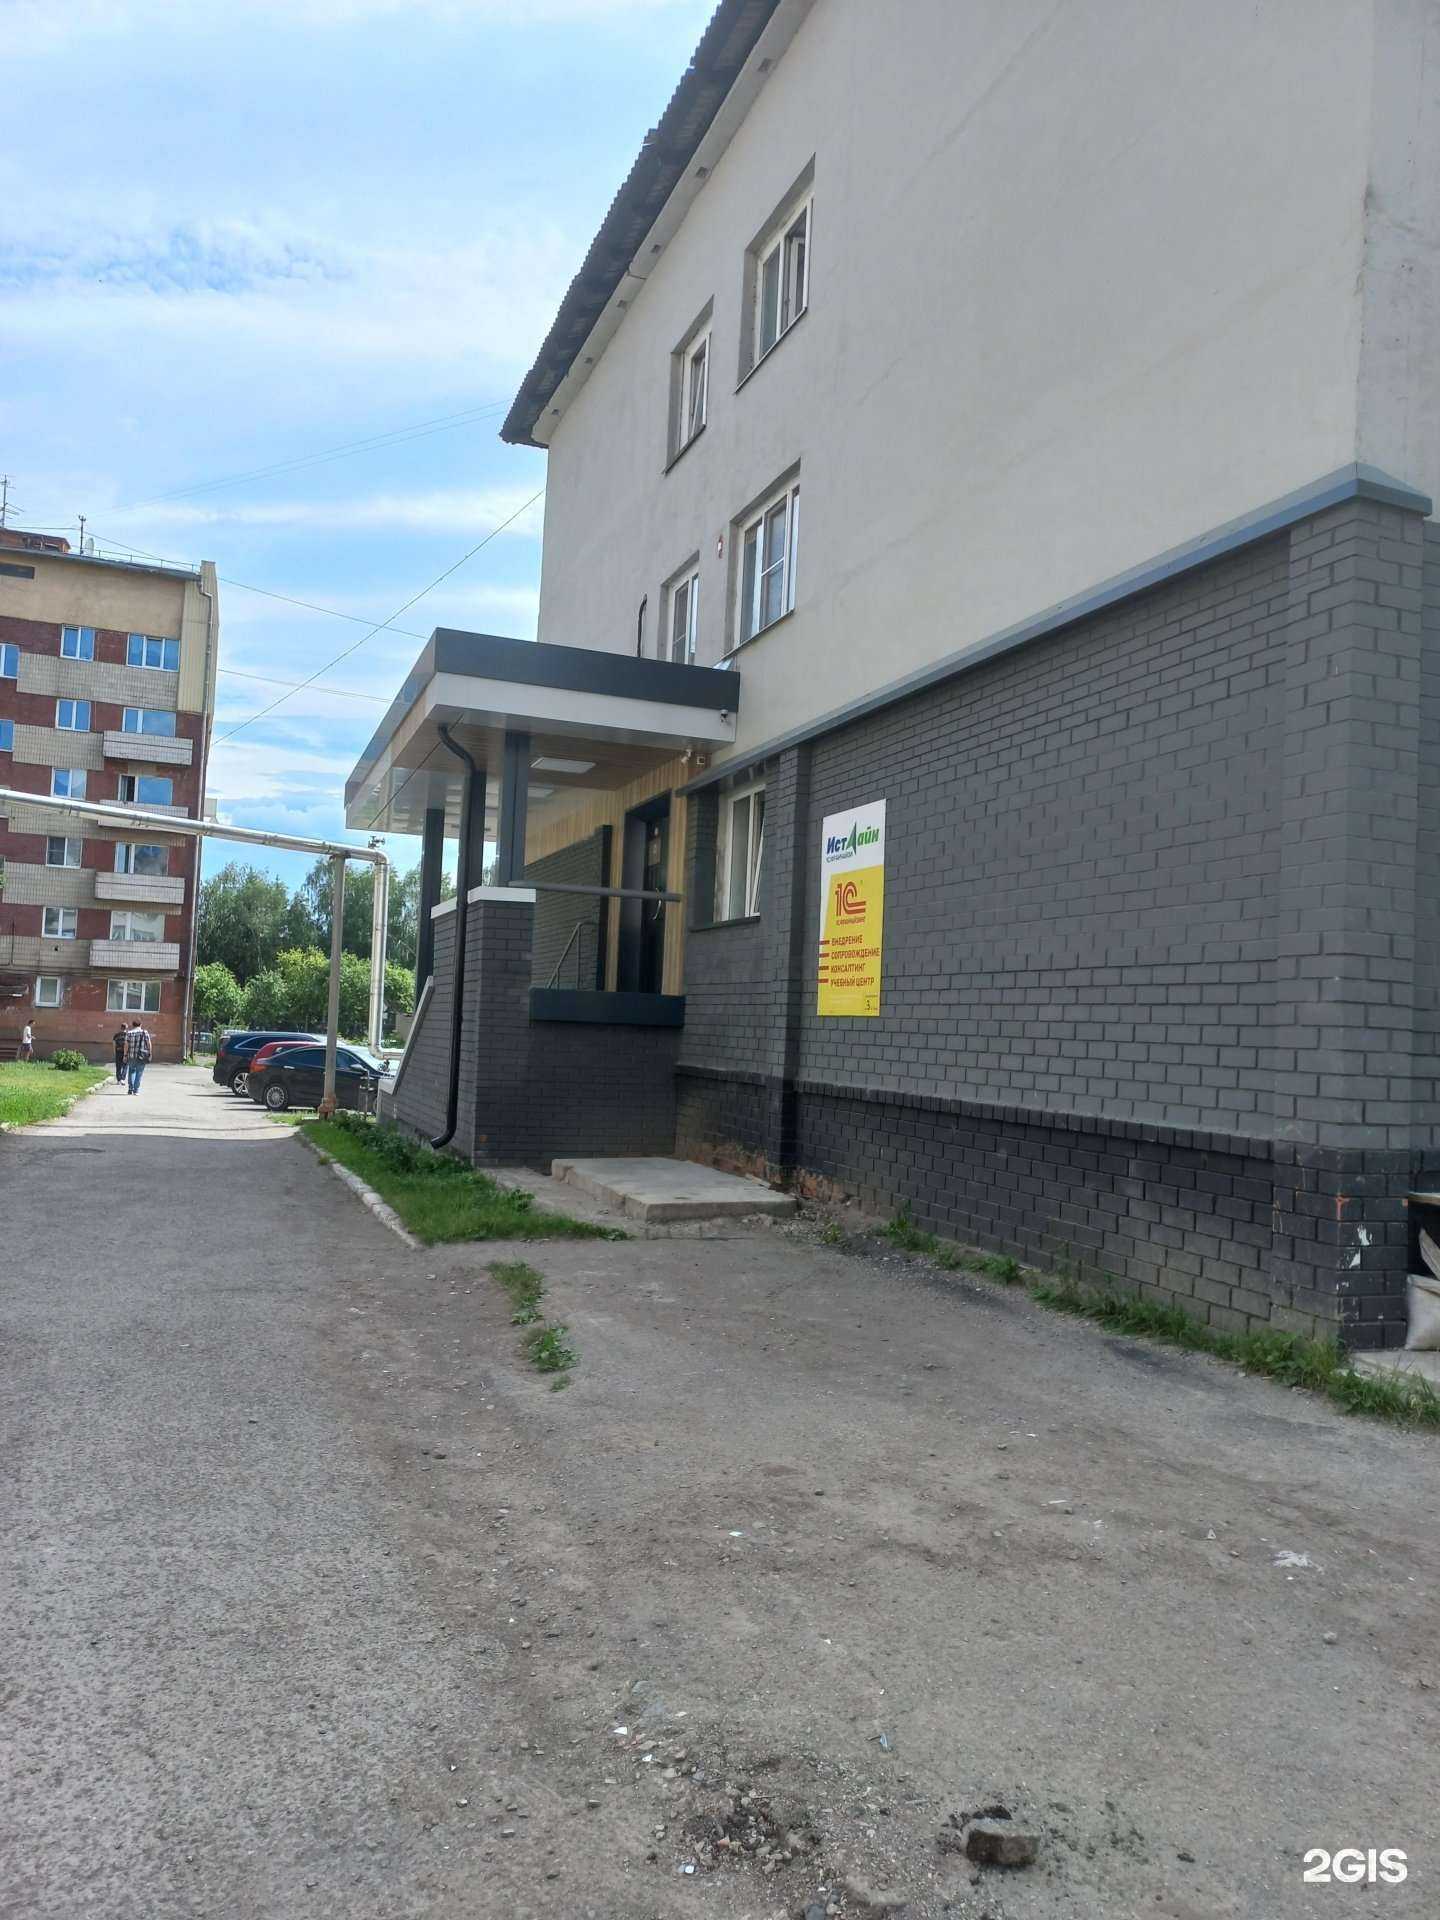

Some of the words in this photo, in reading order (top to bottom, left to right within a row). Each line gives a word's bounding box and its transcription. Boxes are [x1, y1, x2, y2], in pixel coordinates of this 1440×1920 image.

[832, 934, 863, 946] ВНЕДРЕНИЕ
[831, 947, 880, 960] СОПРОВОЖДЕНИЕ
[831, 962, 866, 973] КОНСАЛТИНГ
[831, 976, 855, 988] УЧЕБНЫЙ
[856, 977, 875, 987] ЦЕНТР
